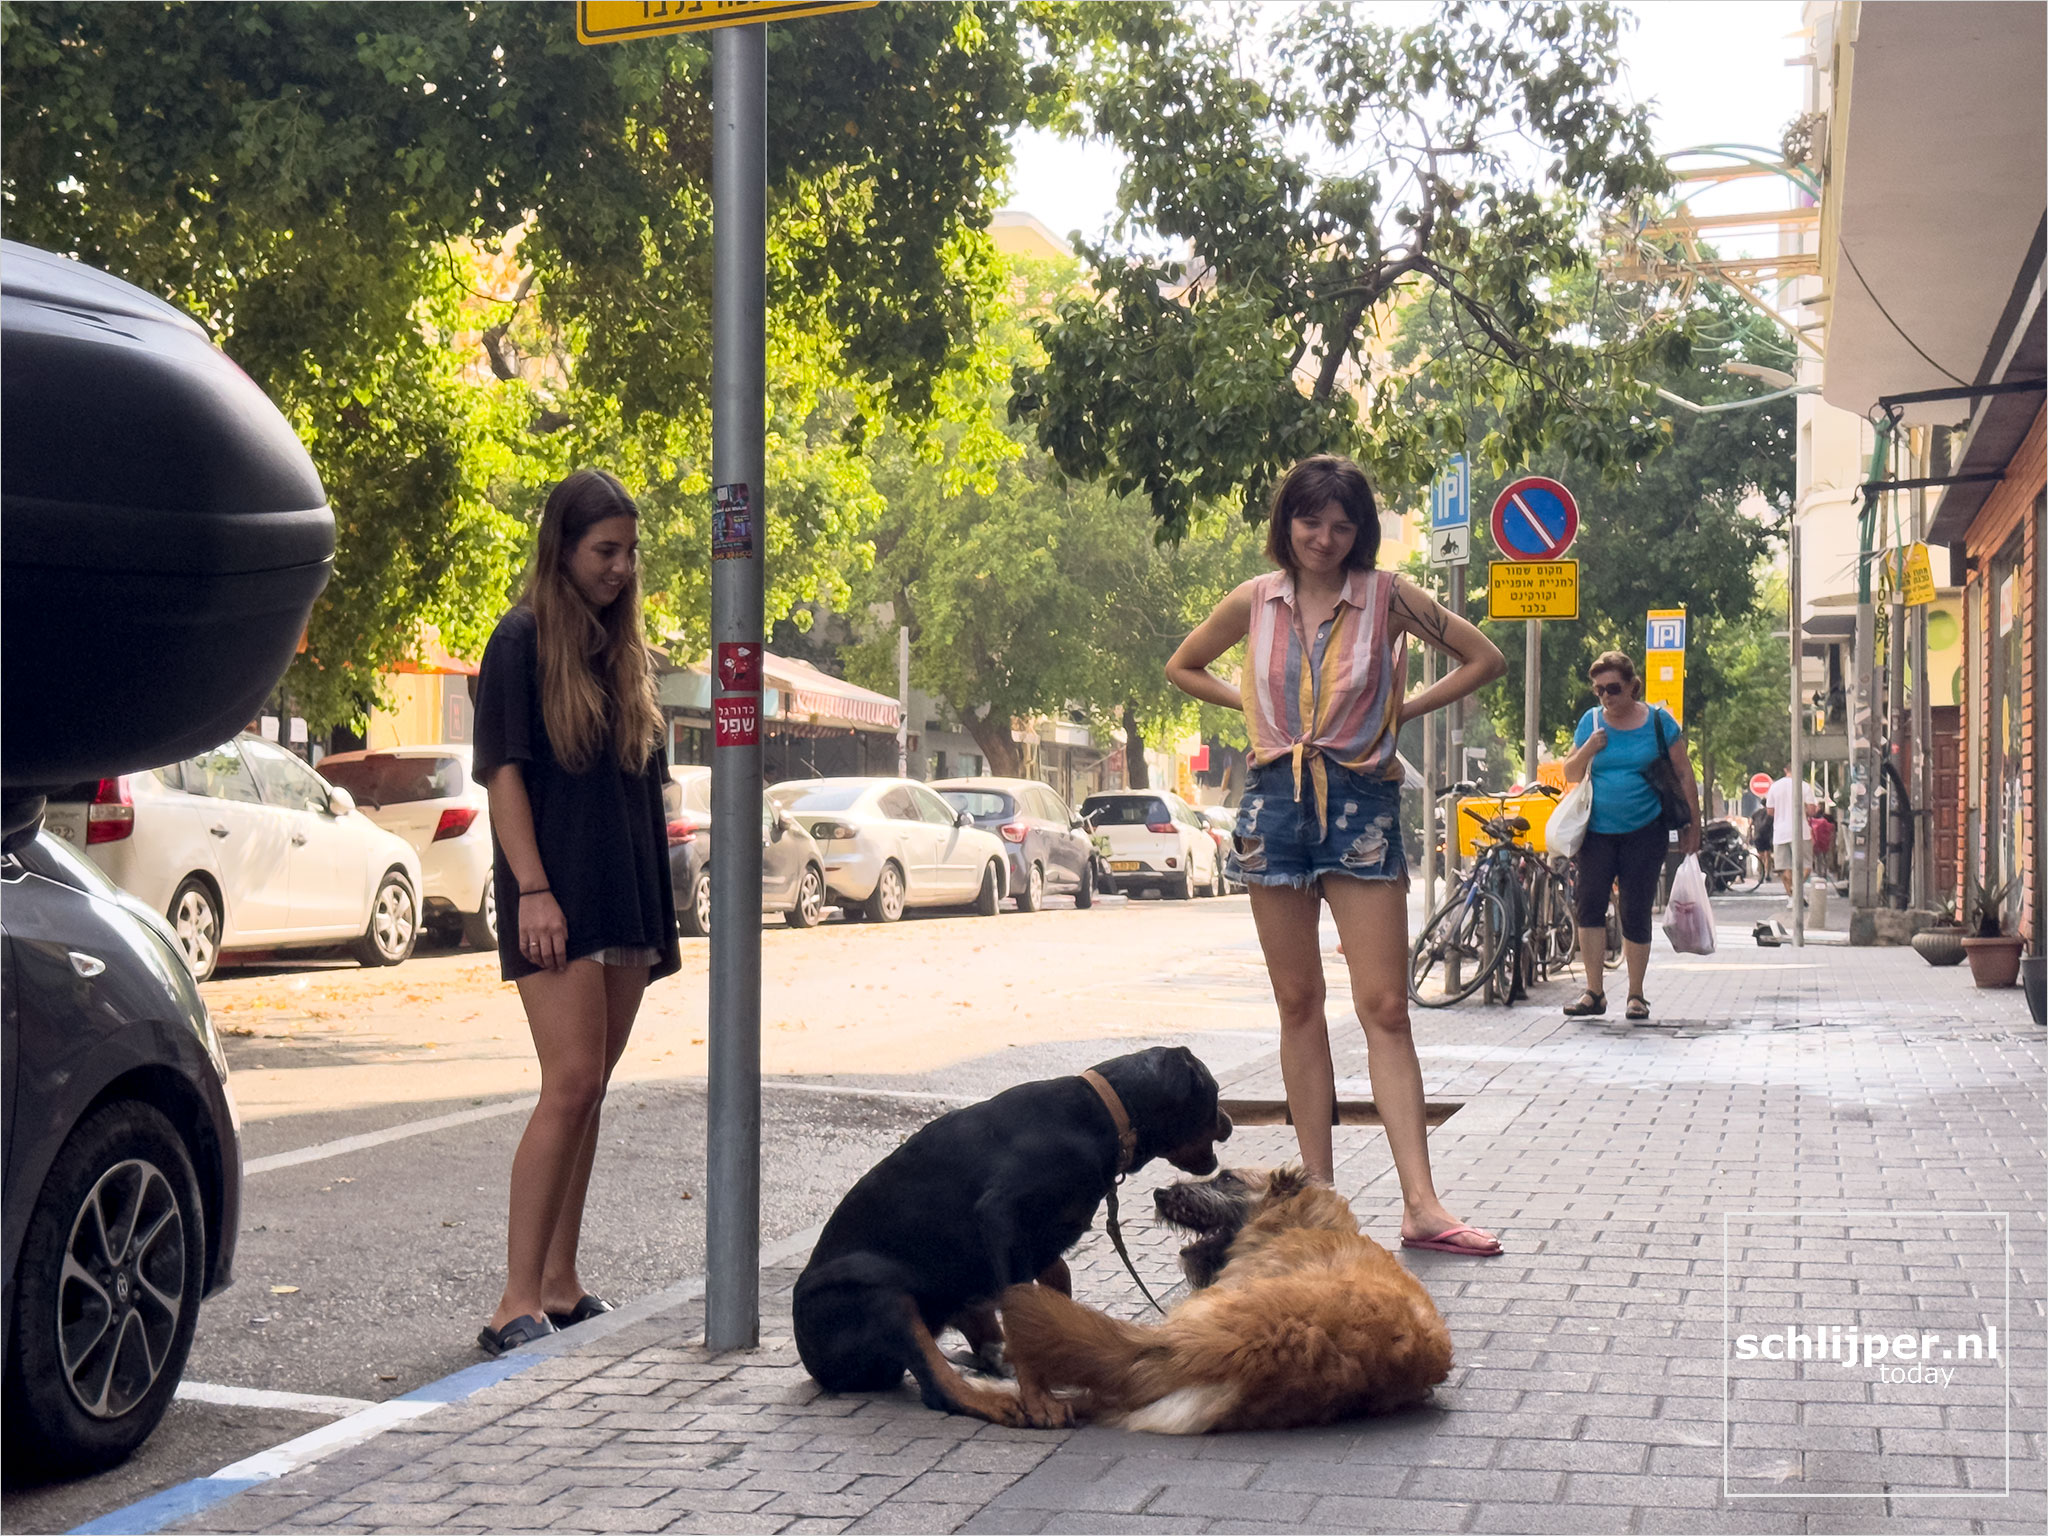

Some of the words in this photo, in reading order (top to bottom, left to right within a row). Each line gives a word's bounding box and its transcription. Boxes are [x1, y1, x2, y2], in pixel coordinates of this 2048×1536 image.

[1505, 566, 1531, 576] שמור
[1537, 566, 1562, 576] מקום
[1494, 578, 1534, 588] אופניים
[1539, 577, 1574, 588] לחניית
[1510, 591, 1557, 601] וקורקינט
[1520, 603, 1547, 613] בלבד
[718, 706, 755, 716] כדורגל
